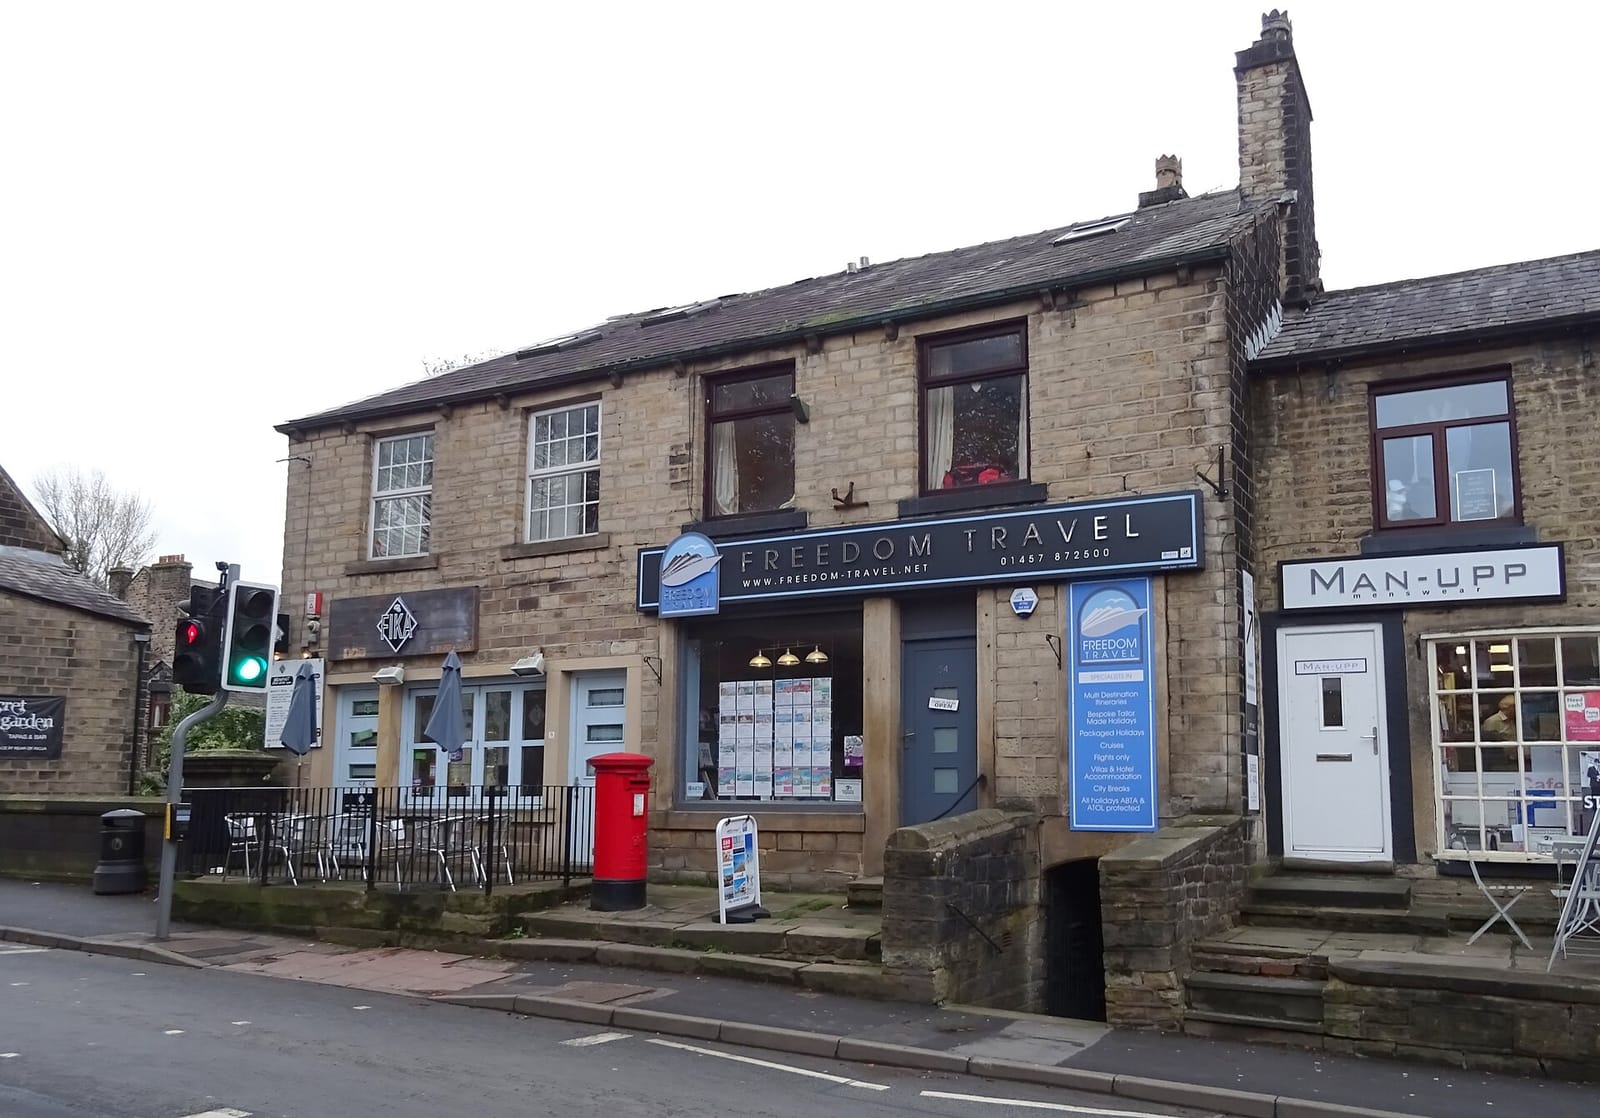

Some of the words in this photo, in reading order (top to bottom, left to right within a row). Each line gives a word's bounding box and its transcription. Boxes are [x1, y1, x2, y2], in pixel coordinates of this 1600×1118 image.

[741, 533, 931, 573] FREEDOM
[963, 513, 1139, 552] TRAVEL
[1001, 554, 1044, 566] 01457
[1054, 548, 1109, 561] 872500
[742, 563, 929, 588] WWW.FREEDOM-TRAVEL.NET
[1353, 587, 1480, 599] menswear
[380, 612, 413, 641] FIKA
[1083, 638, 1137, 651] FREEDOM
[1085, 650, 1135, 660] TRAVEL
[1101, 690, 1138, 699] Destination
[0, 713, 54, 732] garden
[1108, 717, 1137, 725] Holidays
[1116, 729, 1144, 737] Holidays
[1100, 741, 1124, 749] Cruises
[1094, 754, 1114, 762] Flights
[1115, 754, 1130, 762] only
[1093, 785, 1106, 793] City
[1091, 797, 1119, 805] holidays
[1106, 804, 1140, 812] protected
